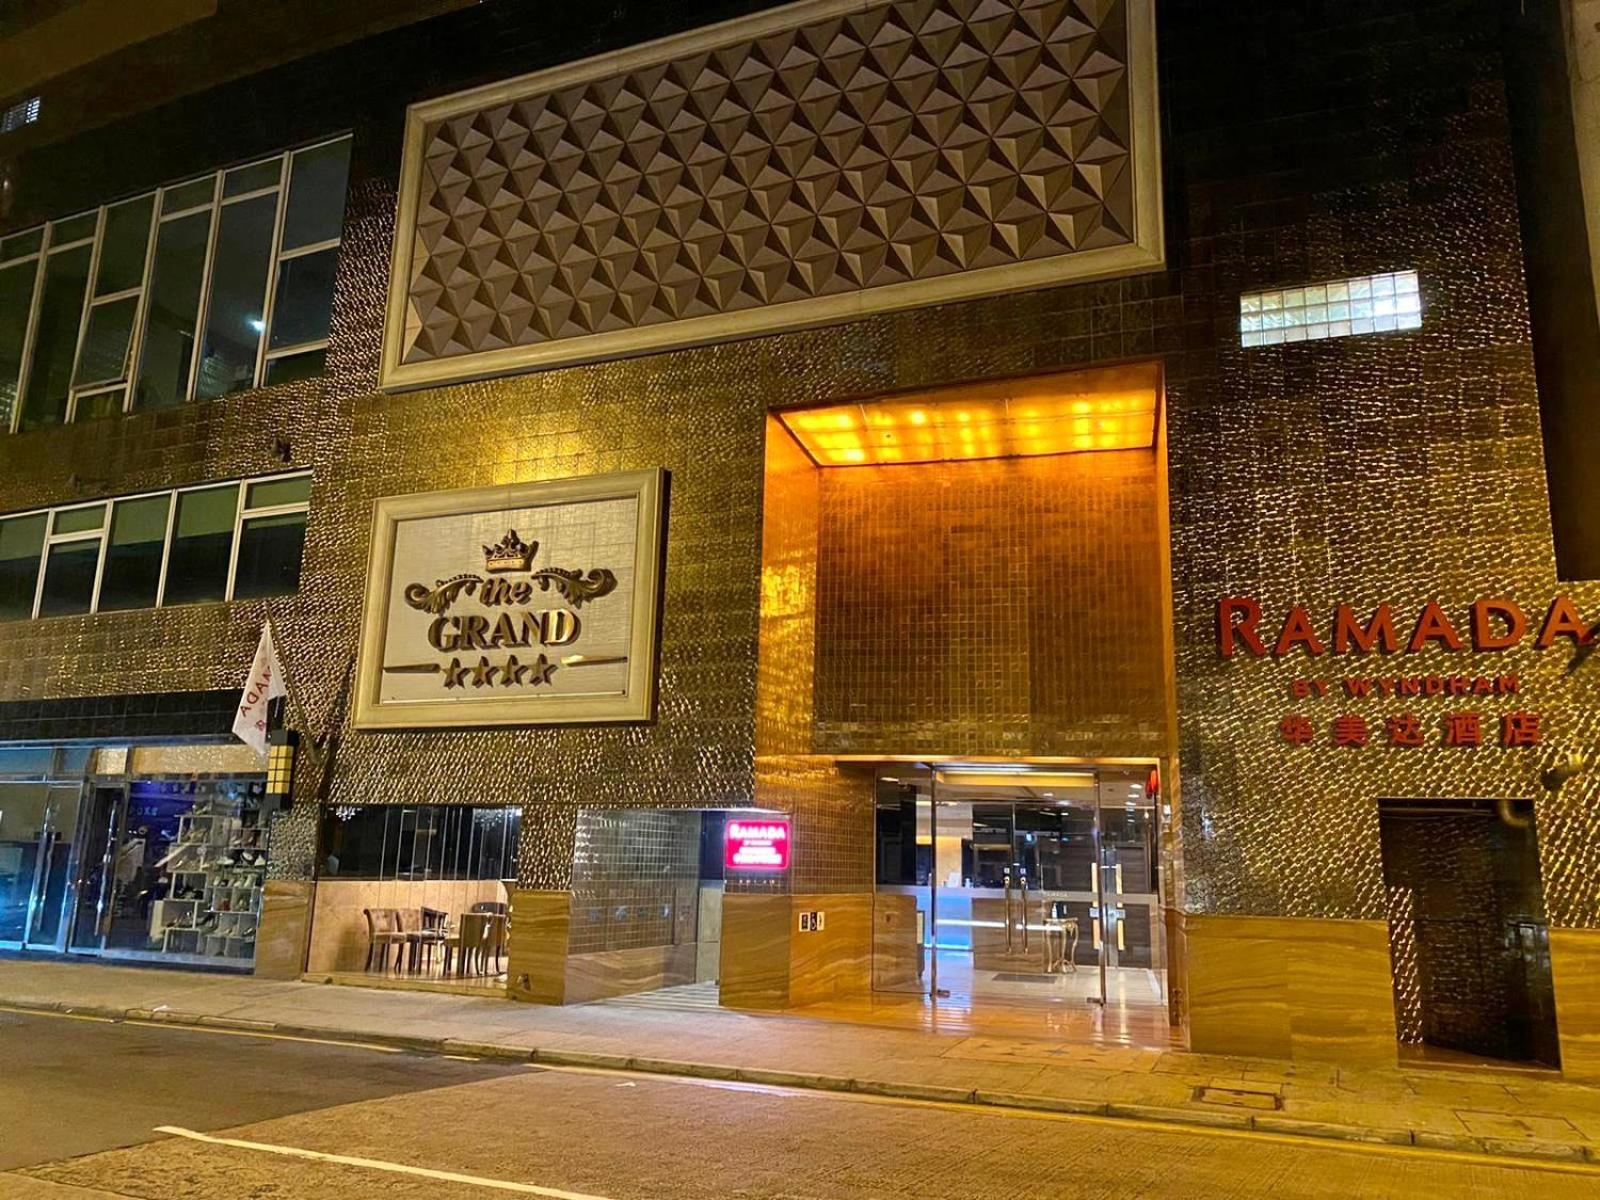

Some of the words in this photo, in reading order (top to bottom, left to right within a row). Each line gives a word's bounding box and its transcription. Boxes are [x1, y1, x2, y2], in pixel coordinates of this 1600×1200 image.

[480, 577, 533, 607] the
[428, 608, 581, 652] GRAND
[1217, 598, 1596, 656] RAMADA
[1291, 678, 1328, 698] BY
[1345, 674, 1520, 697] WYNDHAM
[1280, 711, 1541, 748] 华美达酒店
[730, 823, 786, 839] RAMADA
